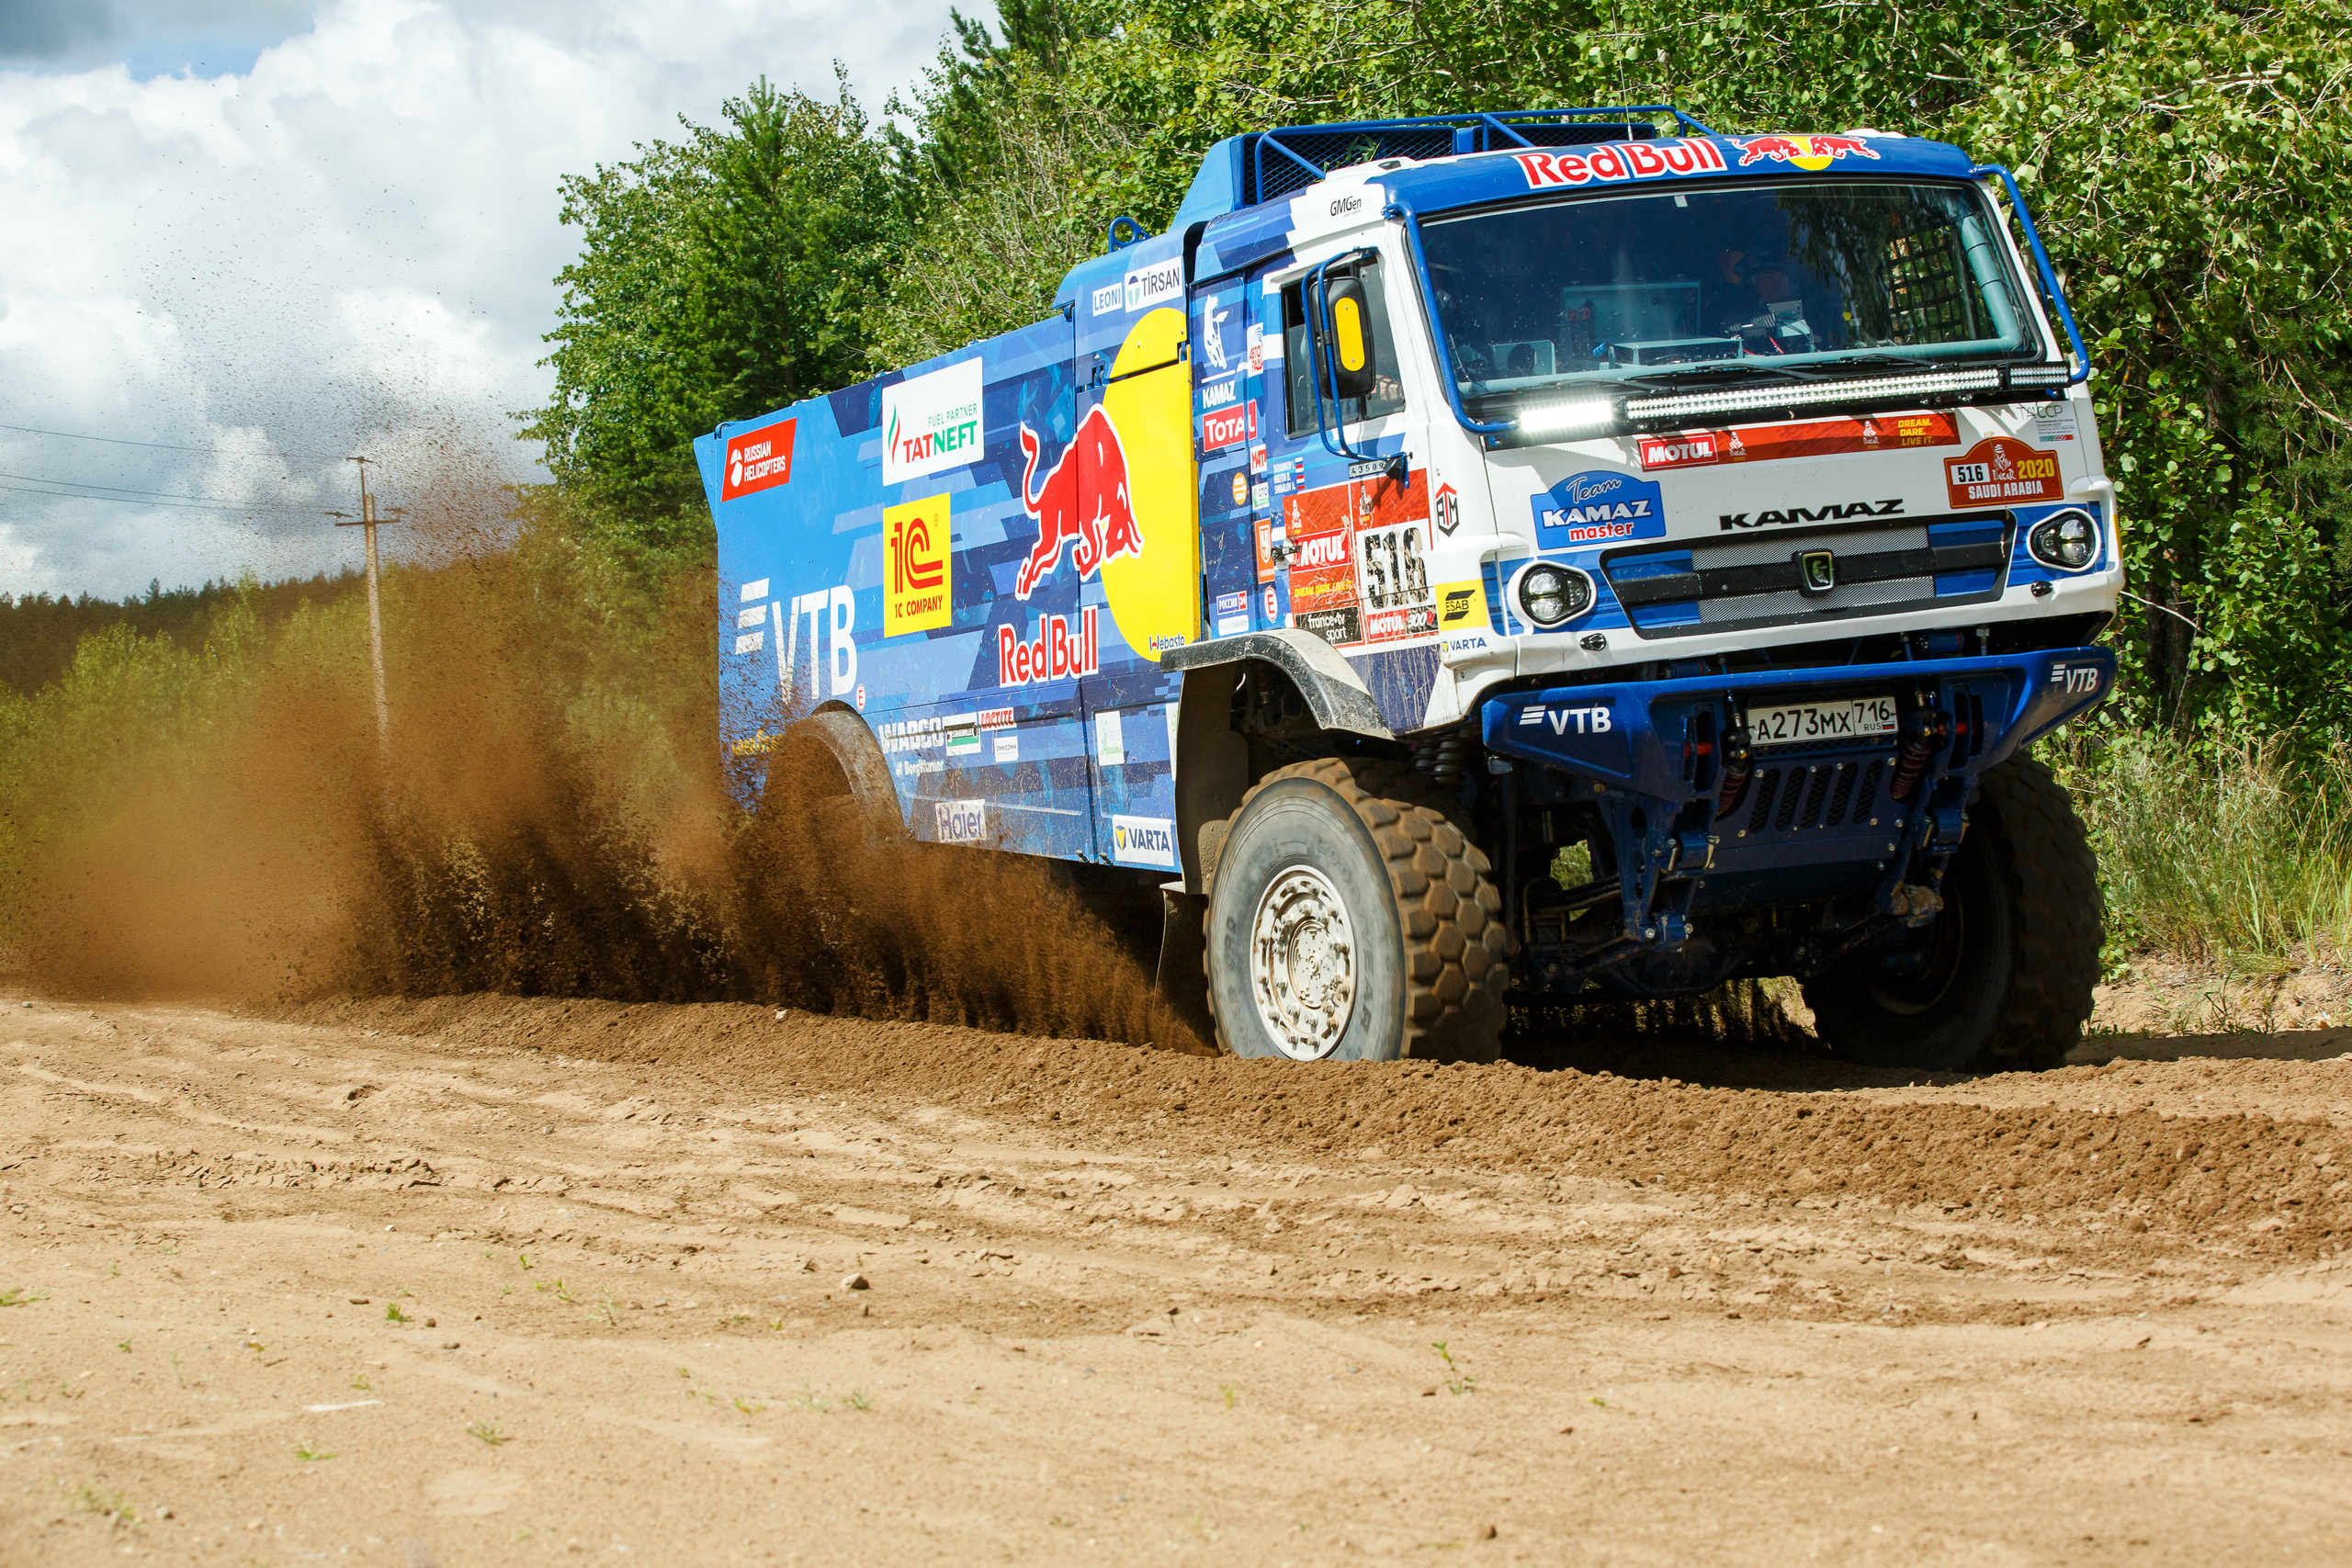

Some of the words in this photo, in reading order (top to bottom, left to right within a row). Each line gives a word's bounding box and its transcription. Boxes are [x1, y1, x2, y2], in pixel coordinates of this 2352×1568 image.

[1513, 145, 1629, 187] Red
[1616, 139, 1726, 178] Bull
[1330, 196, 1362, 216] GMGen
[1094, 287, 1121, 311] LEONI
[1203, 380, 1236, 409] KAMAZ
[928, 414, 944, 428] FUEL
[946, 403, 978, 423] PARTNER
[1898, 418, 1932, 428] DREAM.
[903, 420, 978, 464] TATNEFT
[1900, 428, 1926, 436] DARE.
[1902, 437, 1921, 446] LIVE
[744, 440, 771, 463] RUSSIAN
[1648, 442, 1713, 464] MOTUL
[744, 455, 786, 482] HELICOPTERS
[1958, 465, 1984, 482] 516
[2017, 458, 2055, 479] 2020
[1566, 477, 1621, 504] Team
[1968, 484, 2001, 500] SAUDI
[2004, 480, 2043, 497] ARABIA
[1543, 499, 1652, 529] KAMAZ
[1720, 499, 1905, 531] KAMAZ
[1569, 522, 1634, 542] master
[1296, 536, 1346, 567] MOTUL
[895, 604, 903, 618] 1C
[907, 595, 943, 616] COMPANY
[1445, 600, 1469, 612] ESAB
[1326, 626, 1347, 642] sport
[1370, 615, 1405, 636] MOTUL
[1408, 611, 1434, 628] 300V
[773, 585, 857, 705] VTB
[1000, 615, 1047, 686] Red
[1049, 605, 1098, 679] Bull
[1149, 633, 1184, 653] Webasto
[1450, 637, 1487, 651] VARTA
[2066, 668, 2098, 694] VTB
[980, 710, 1014, 729] LOCTITE
[1548, 706, 1611, 735] VTB
[1854, 701, 1890, 724] 716
[878, 717, 944, 754] WABCO
[1864, 723, 1882, 731] RUS
[939, 804, 981, 840] Haier
[1129, 829, 1170, 852] VARTA
